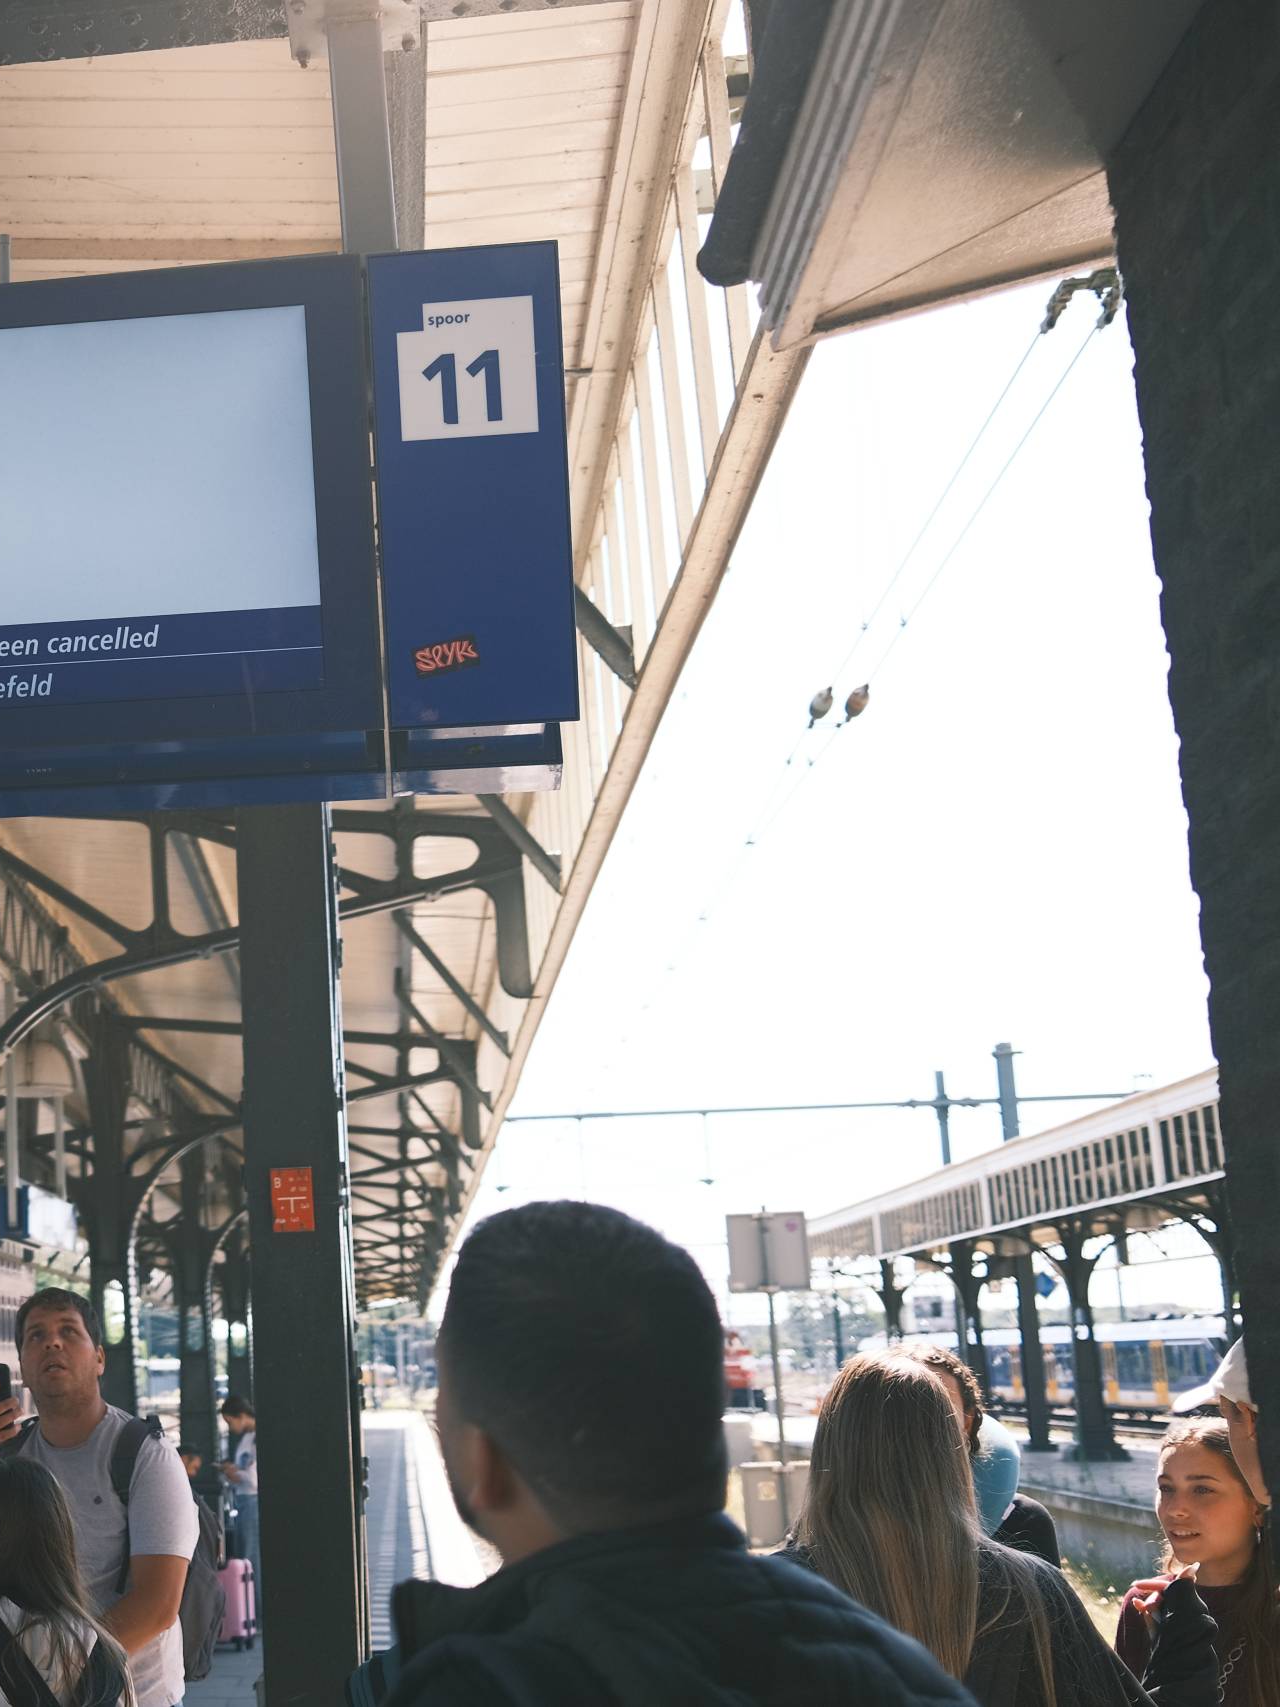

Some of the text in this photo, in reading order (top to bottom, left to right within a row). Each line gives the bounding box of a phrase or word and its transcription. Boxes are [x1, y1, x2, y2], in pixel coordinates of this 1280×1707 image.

[427, 313, 470, 328] spoor
[422, 349, 503, 424] 11
[47, 624, 160, 654] cancelled
